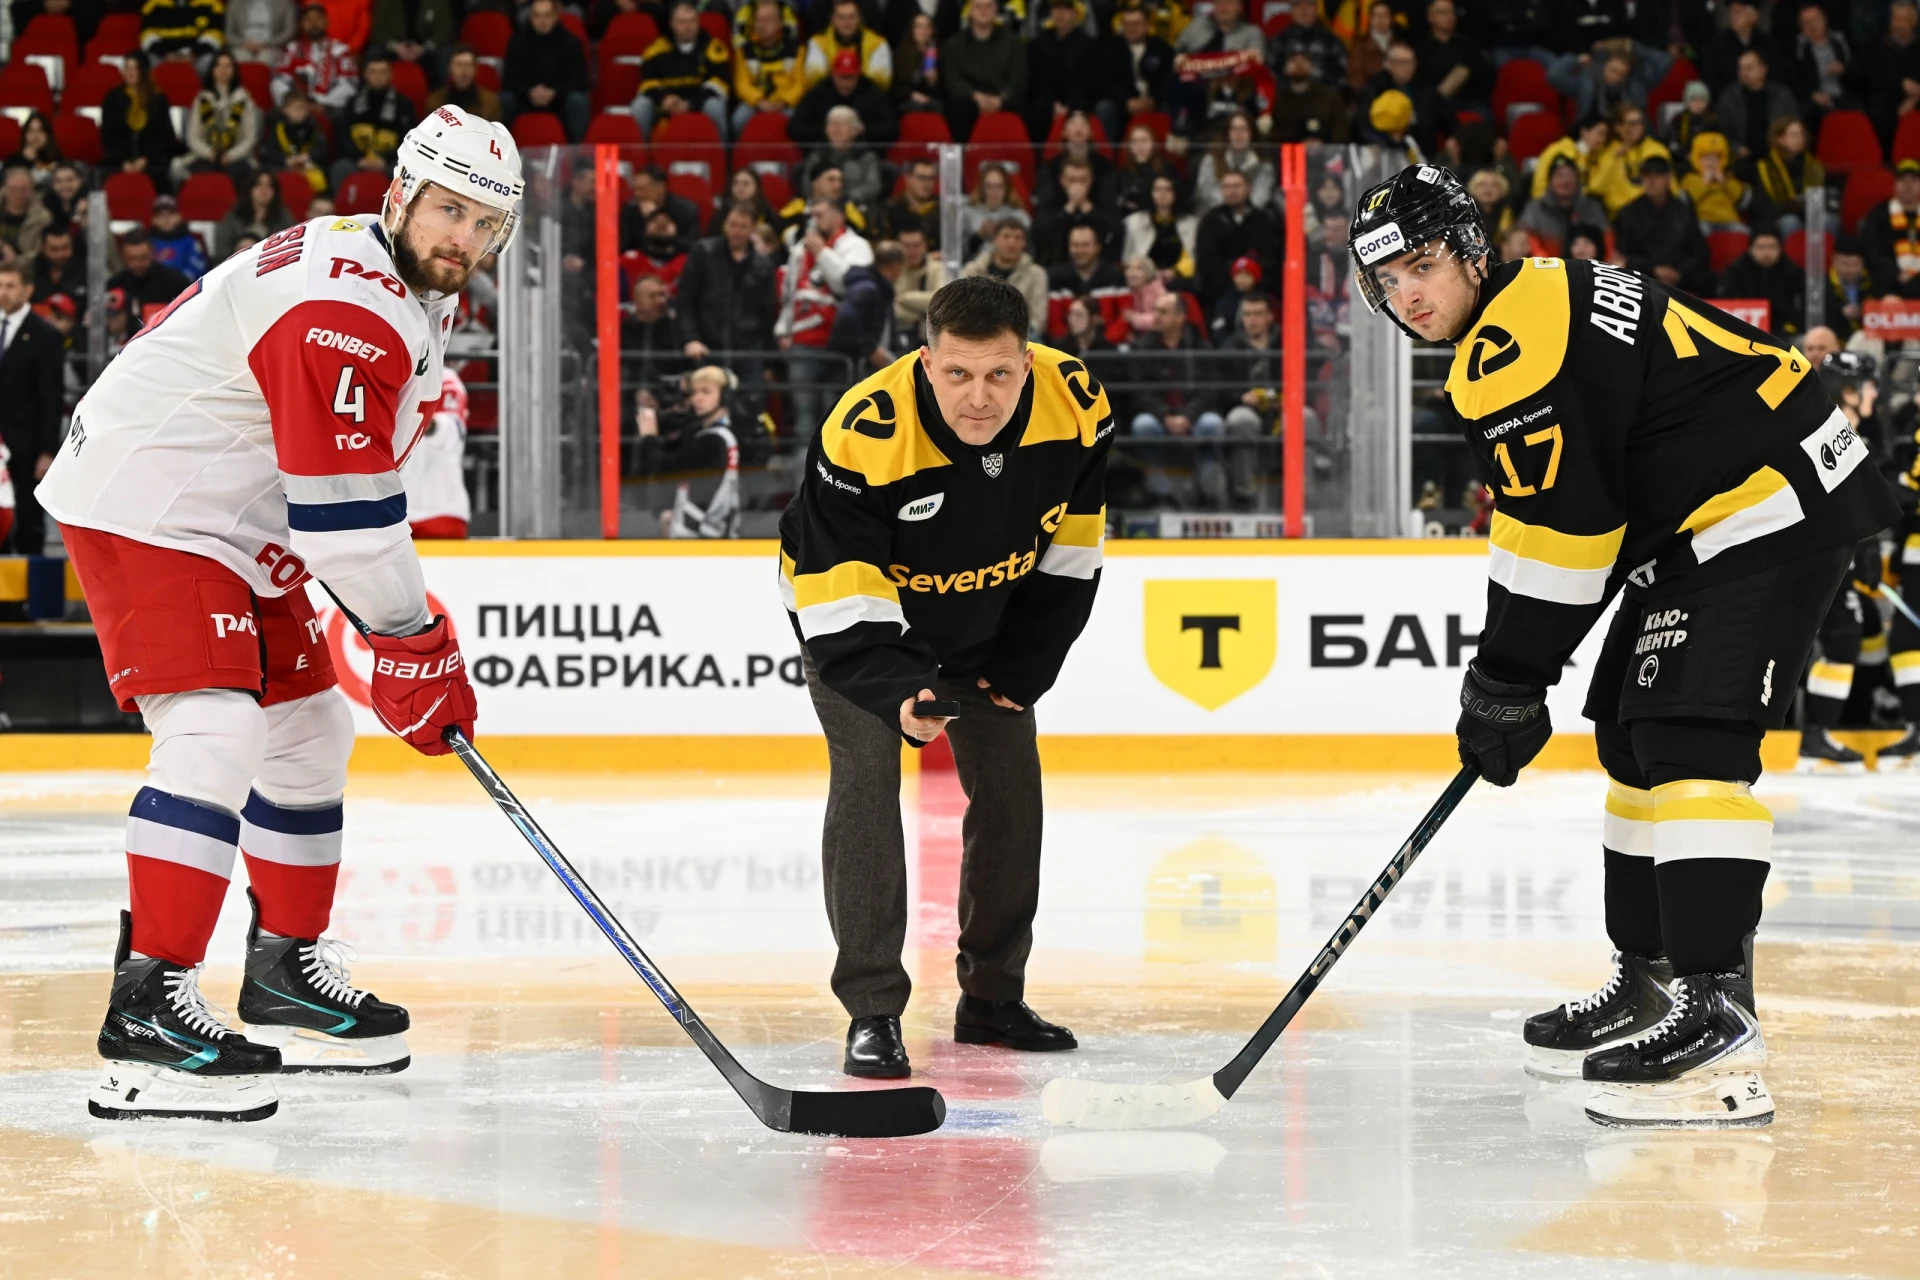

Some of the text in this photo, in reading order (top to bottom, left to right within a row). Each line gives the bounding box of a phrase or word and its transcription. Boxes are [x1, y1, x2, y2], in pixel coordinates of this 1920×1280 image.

[489, 139, 502, 160] 4
[305, 327, 388, 363] FONBET
[333, 364, 366, 424] 4
[1522, 405, 1553, 424] брокер
[1832, 421, 1858, 457] СОВК
[1493, 423, 1564, 498] 17
[834, 479, 862, 496] брокер
[908, 501, 936, 516] МИР
[477, 604, 662, 643] ПИЦЦА
[1635, 629, 1688, 656] ЦЕНТР
[472, 653, 808, 689] ФАБРИКА.РФ
[1309, 838, 1421, 984] SOYUZ
